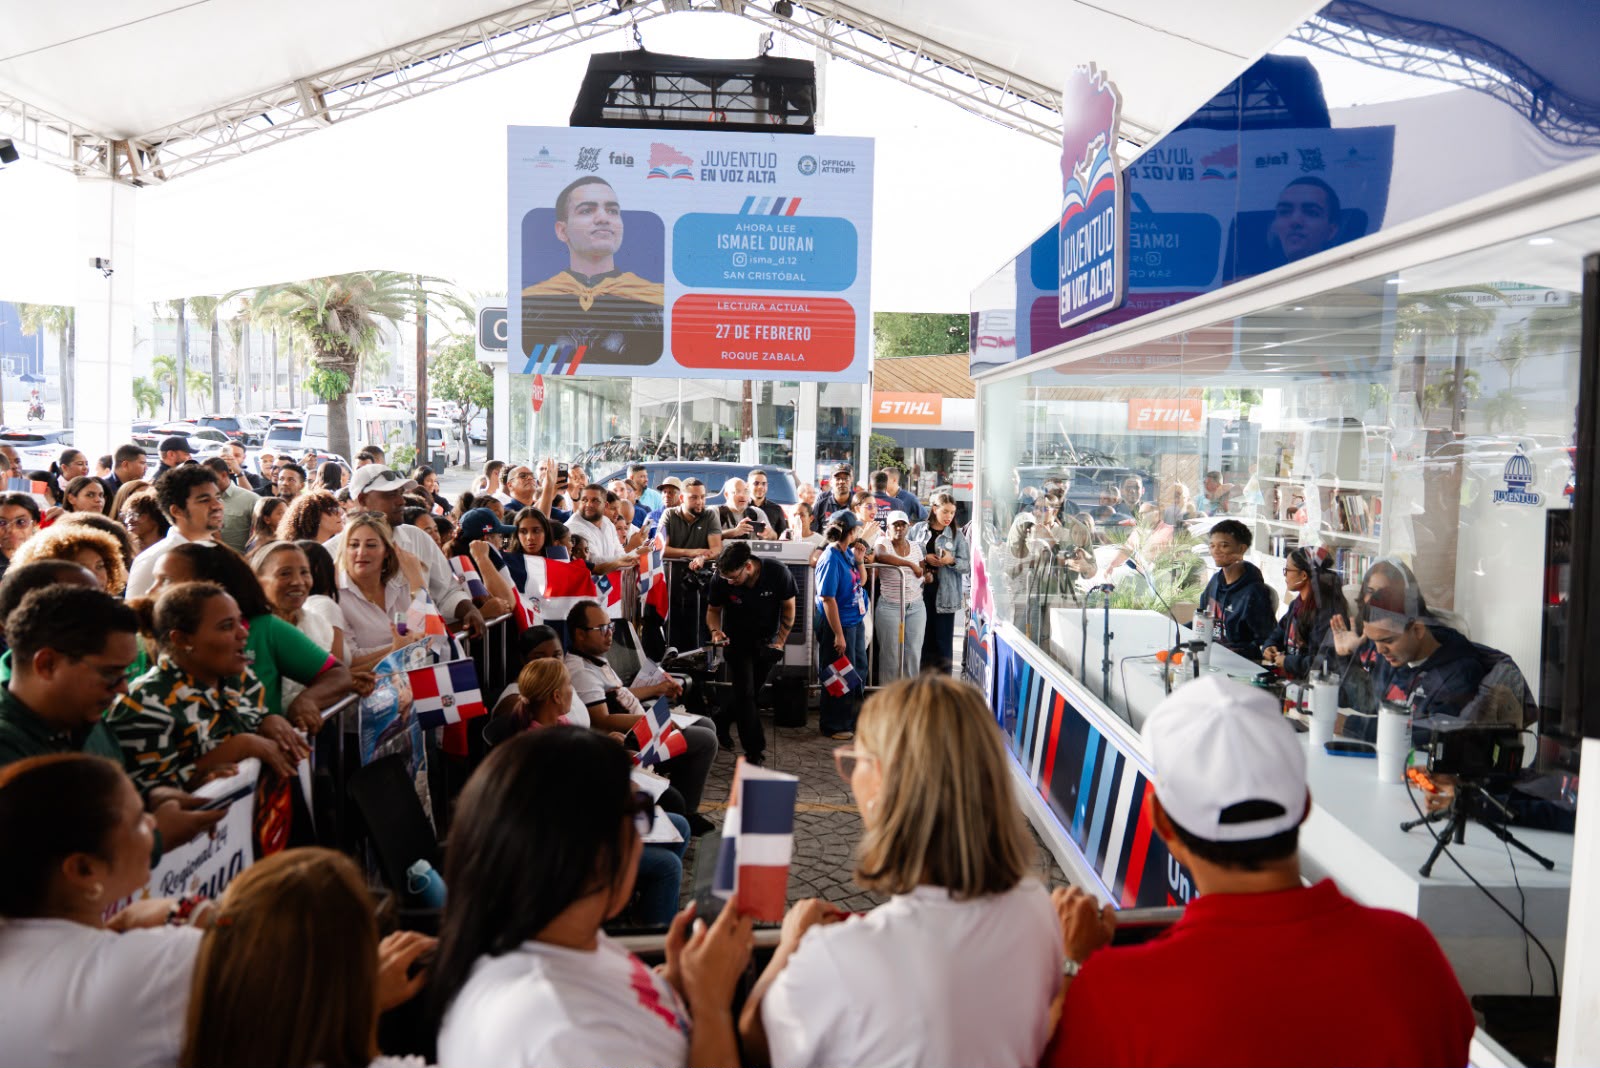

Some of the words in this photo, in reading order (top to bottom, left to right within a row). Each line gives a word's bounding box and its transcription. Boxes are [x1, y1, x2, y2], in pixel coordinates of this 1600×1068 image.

[609, 151, 634, 167] faia
[701, 150, 777, 168] JUVENTUD
[822, 159, 856, 167] OFFICIAL
[701, 169, 716, 182] EN
[720, 169, 744, 182] VOZ
[747, 170, 776, 183] ALTA
[735, 223, 773, 232] AHORA
[777, 225, 796, 233] LEE
[717, 234, 765, 250] ISMAEL
[770, 235, 814, 252] DURAN
[1061, 206, 1113, 280] JUVENTUD
[723, 271, 745, 279] SAN
[748, 271, 806, 281] CRISTÓBAL
[1072, 271, 1088, 310] VOZ
[1089, 258, 1113, 302] ALTA
[717, 301, 766, 311] LECTURA
[769, 303, 811, 312] ACTUAL
[715, 324, 731, 339] 27
[734, 324, 750, 339] DE
[755, 325, 811, 341] FEBRERO
[721, 351, 759, 360] ROQUE
[762, 352, 805, 362] ZABALA
[879, 400, 936, 415] STIHL
[1137, 407, 1195, 422] STIHL
[1493, 490, 1540, 505] JUVENTUD
[160, 840, 213, 898] Regional
[1168, 852, 1190, 905] Un
